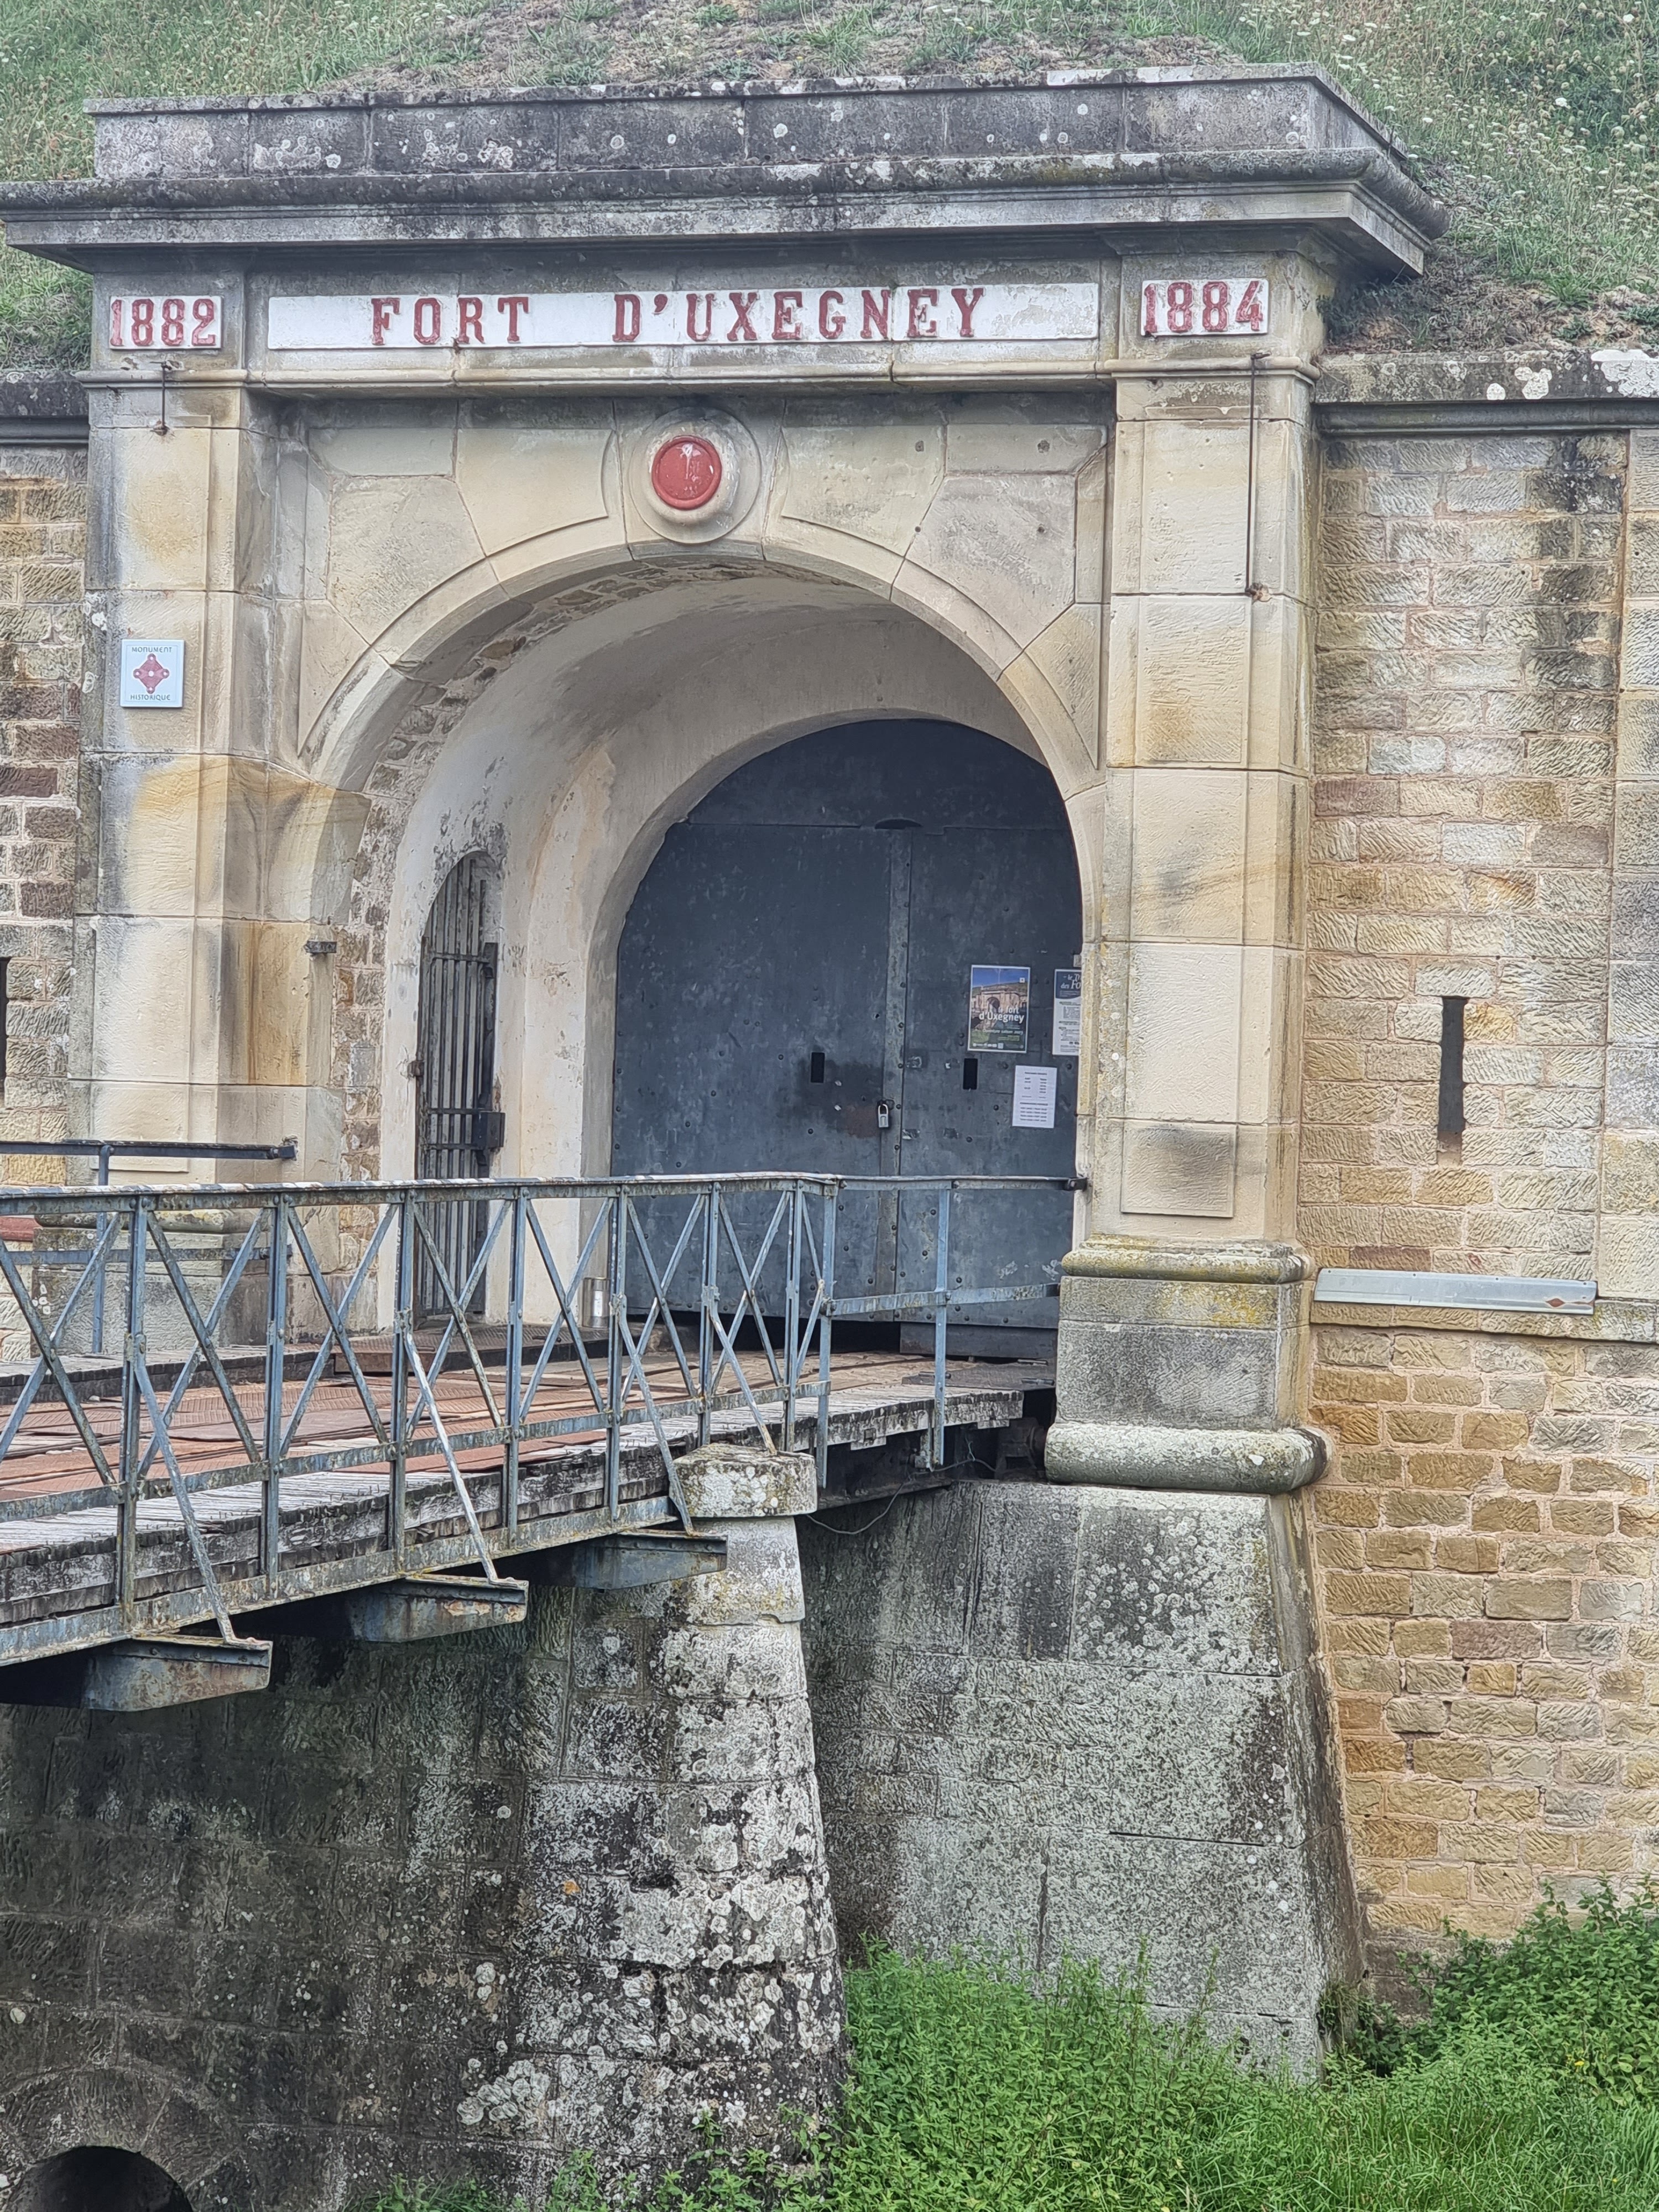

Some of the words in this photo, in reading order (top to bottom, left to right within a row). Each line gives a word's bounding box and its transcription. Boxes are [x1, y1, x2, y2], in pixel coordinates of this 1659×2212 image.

[111, 299, 216, 346] 1882
[371, 296, 529, 346] FORT
[612, 288, 985, 343] D'UXEGNEY
[1144, 280, 1264, 332] 1884
[979, 1011, 1025, 1024] d'Uxegney
[1005, 1004, 1020, 1014] fort
